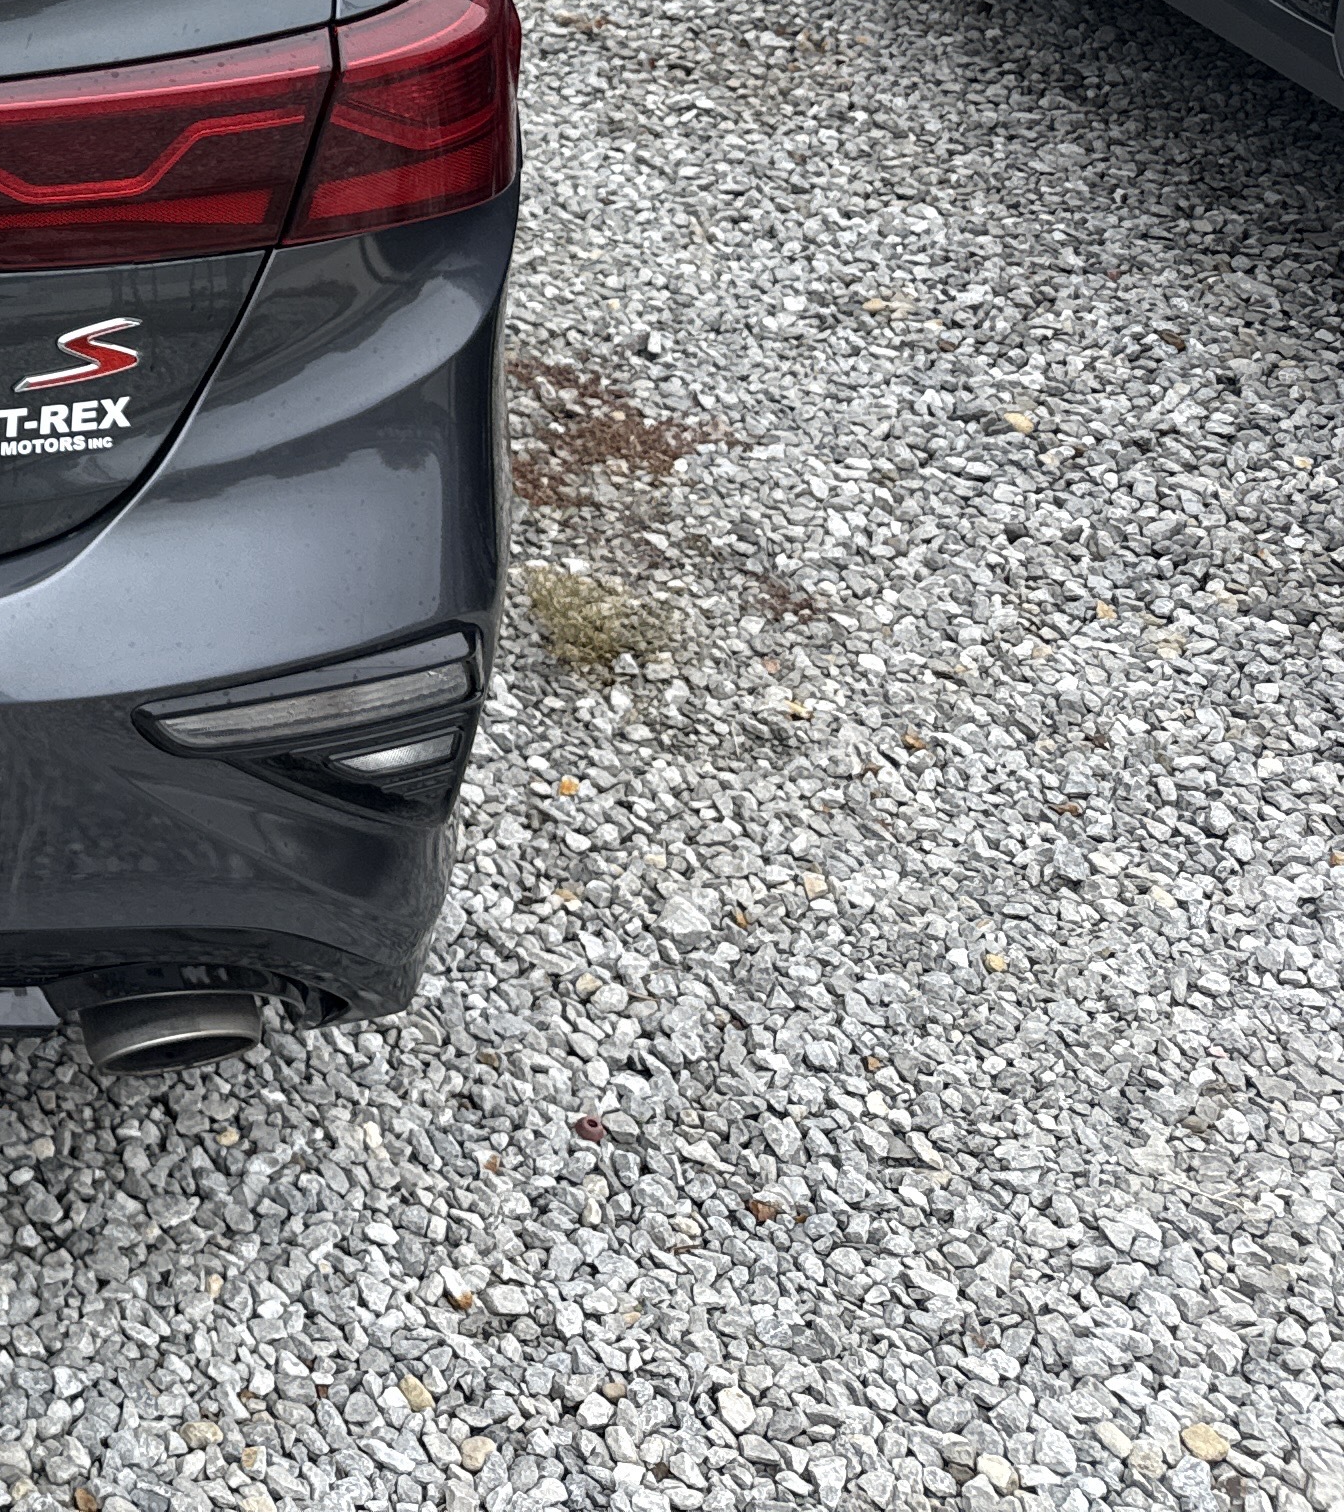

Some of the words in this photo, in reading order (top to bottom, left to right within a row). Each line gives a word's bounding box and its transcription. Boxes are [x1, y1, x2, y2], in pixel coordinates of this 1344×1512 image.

[12, 317, 143, 393] S
[0, 435, 86, 457] MOTORS
[87, 437, 113, 450] INC
